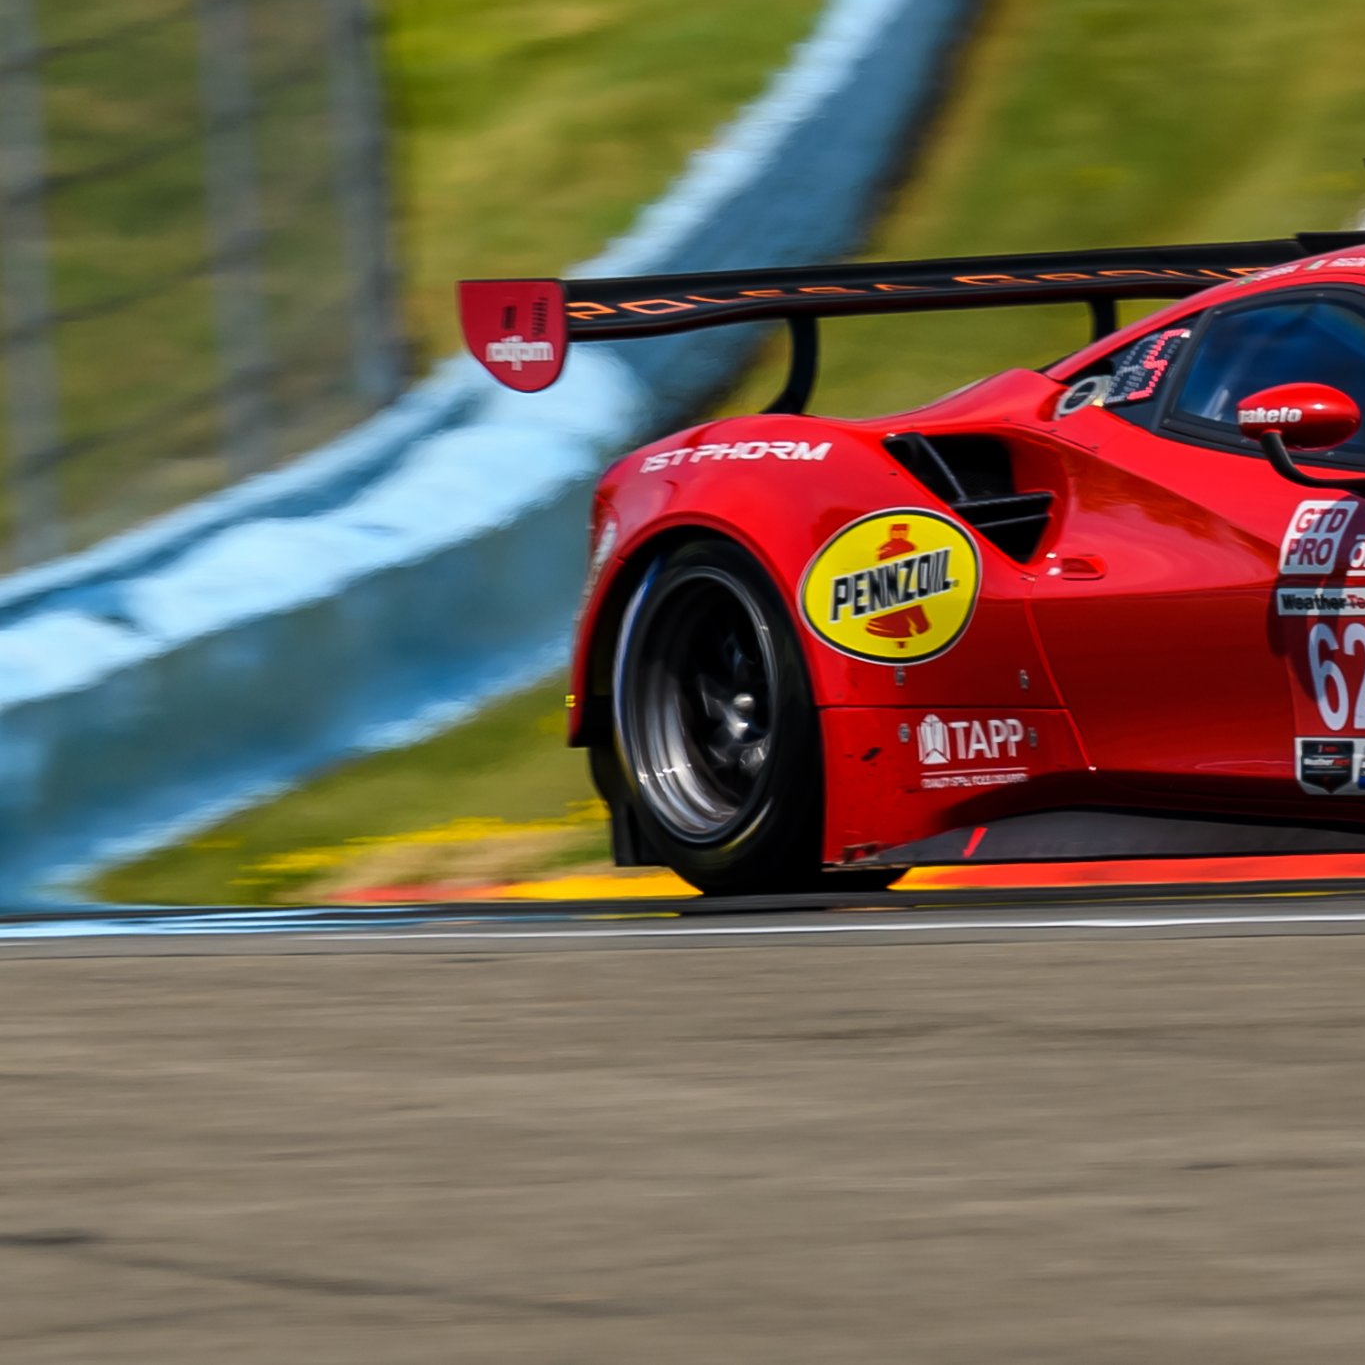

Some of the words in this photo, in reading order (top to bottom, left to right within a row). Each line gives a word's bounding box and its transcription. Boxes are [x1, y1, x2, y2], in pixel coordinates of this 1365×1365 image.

[689, 441, 834, 464] PHORM
[1295, 508, 1349, 534] GTD
[1284, 537, 1334, 566] PRO
[829, 546, 952, 624] PENNZOIL
[948, 718, 1024, 760] TAPP
